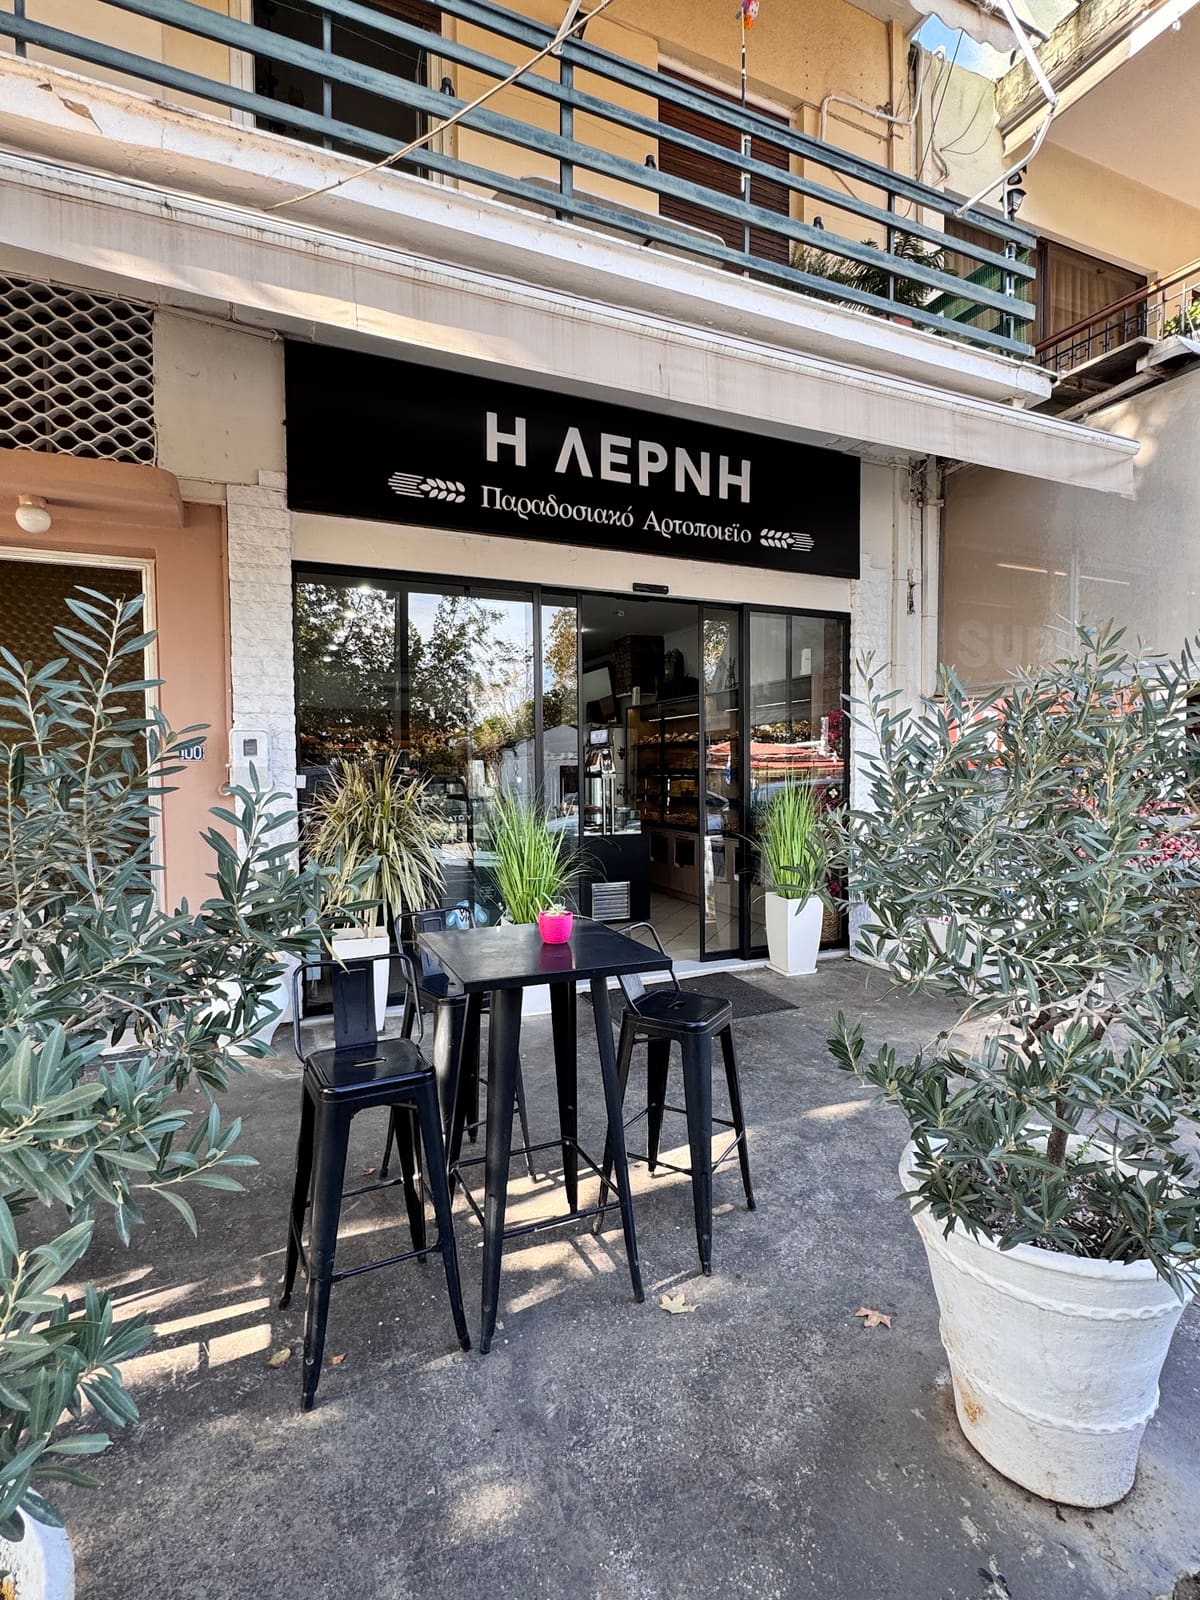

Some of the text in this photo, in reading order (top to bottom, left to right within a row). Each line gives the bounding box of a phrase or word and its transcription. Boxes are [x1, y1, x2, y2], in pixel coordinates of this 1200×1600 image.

[486, 411, 751, 504] Η ΛΕΡΝΗ
[481, 485, 635, 528] Παραδοσιακό
